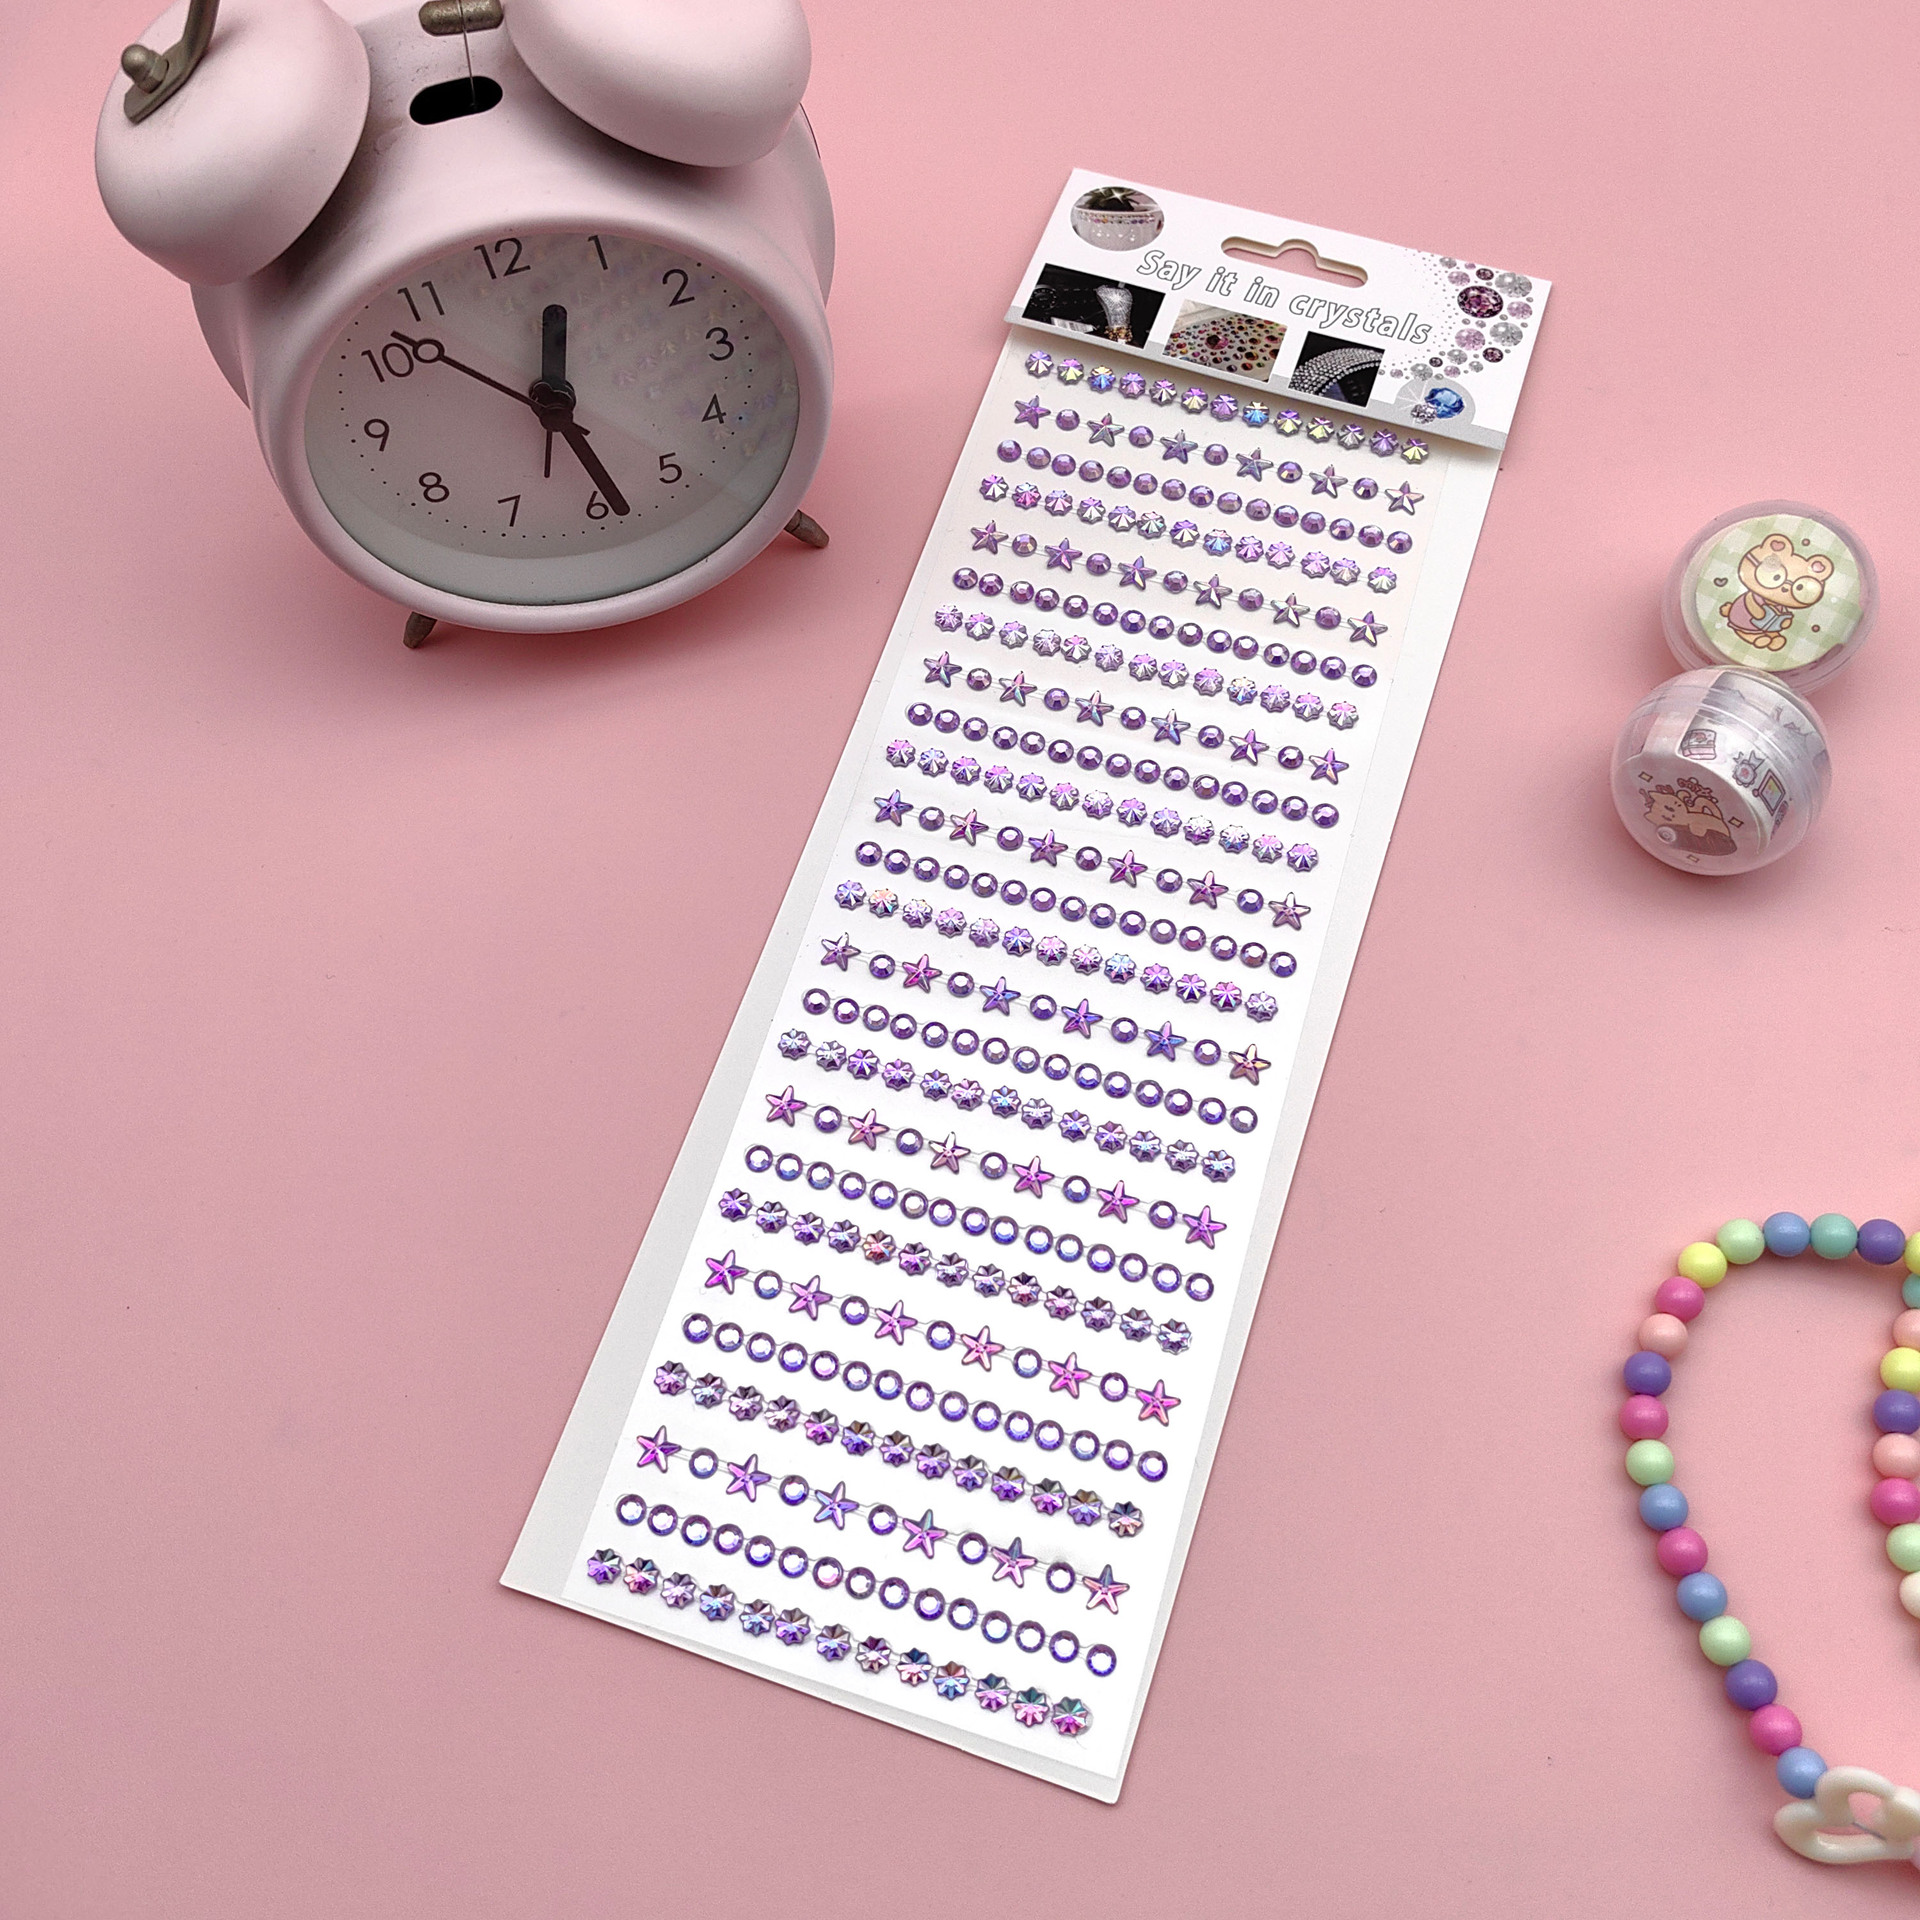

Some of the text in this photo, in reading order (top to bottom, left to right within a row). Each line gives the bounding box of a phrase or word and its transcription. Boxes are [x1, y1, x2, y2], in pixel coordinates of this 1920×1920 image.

[474, 237, 531, 280] 12
[587, 235, 609, 270] 1
[397, 280, 446, 322] 11
[661, 268, 695, 307] 2
[1136, 249, 1433, 345] Say it in crystals
[705, 327, 735, 361] 3
[361, 342, 415, 383] 10
[701, 394, 727, 425] 4
[363, 418, 390, 452] 9
[658, 452, 683, 484] 5
[418, 471, 450, 503] 8
[497, 494, 521, 527] 7
[585, 491, 609, 520] 6
